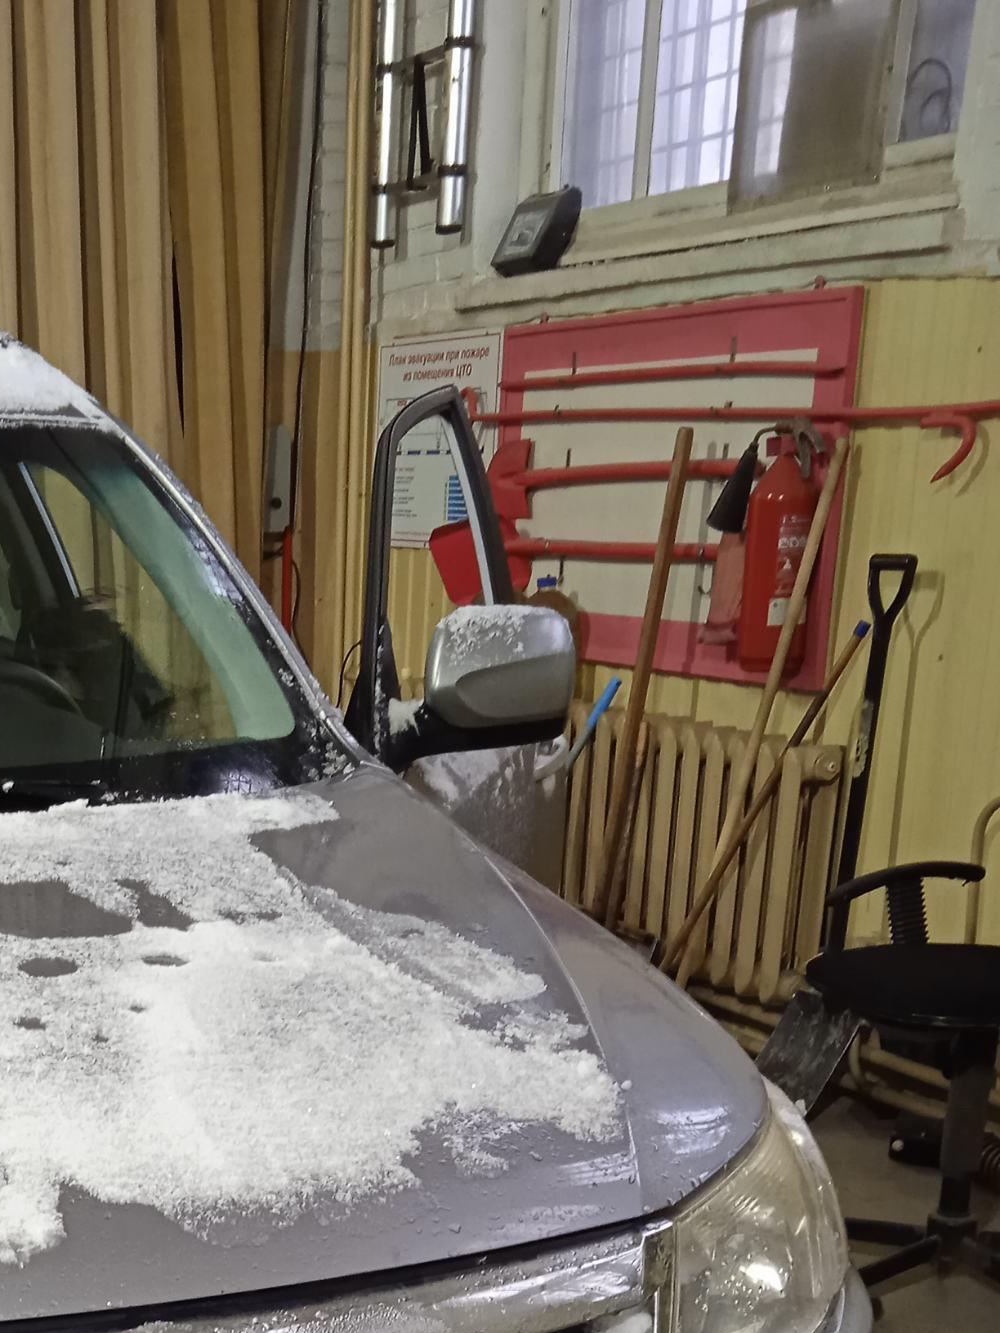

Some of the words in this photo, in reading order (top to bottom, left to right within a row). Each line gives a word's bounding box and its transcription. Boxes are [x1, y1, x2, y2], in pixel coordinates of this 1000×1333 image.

[389, 353, 406, 366] План
[408, 351, 445, 365] эвакуации
[446, 350, 460, 363] при
[461, 346, 490, 361] пожаре
[403, 371, 412, 381] из
[413, 368, 455, 380] помещения
[456, 363, 473, 379] ЦТО
